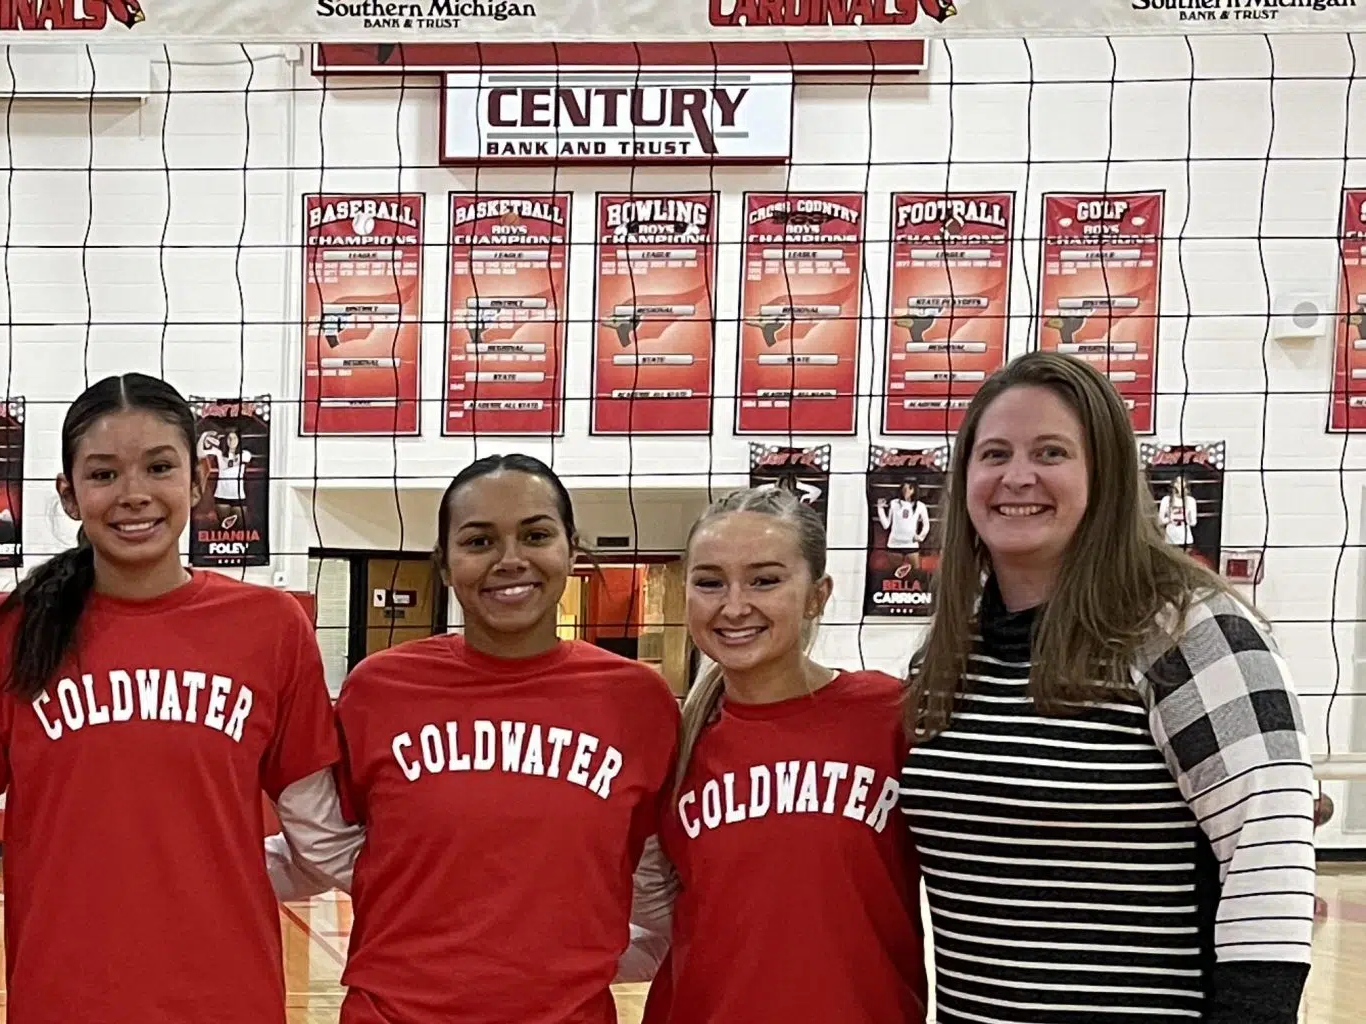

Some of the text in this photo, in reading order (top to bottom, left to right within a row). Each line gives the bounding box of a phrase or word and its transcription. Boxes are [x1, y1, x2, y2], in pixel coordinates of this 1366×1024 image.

[317, 0, 536, 20] Southern Michigan
[1179, 9, 1280, 20] BANK & TRUST
[363, 18, 461, 28] BANK & TRUST
[487, 87, 750, 154] CENTURY
[486, 141, 691, 155] BANK AND TRUST
[309, 199, 418, 227] BASEBALL
[454, 199, 564, 225] BASKETBALL
[606, 199, 708, 226] BOWLING
[797, 199, 859, 224] COUNTRY
[896, 200, 1007, 228] FOOTBALL
[1076, 200, 1129, 221] GOLF
[453, 235, 564, 244] CHAMPIONS
[638, 224, 675, 234] BOYS
[1083, 224, 1120, 234] BOYS
[308, 235, 418, 245] CHAMPIONS
[882, 579, 922, 591] BELLA
[33, 669, 253, 742] COLDWATER
[392, 720, 623, 799] COLDWATER
[678, 760, 900, 839] COLDWATER
